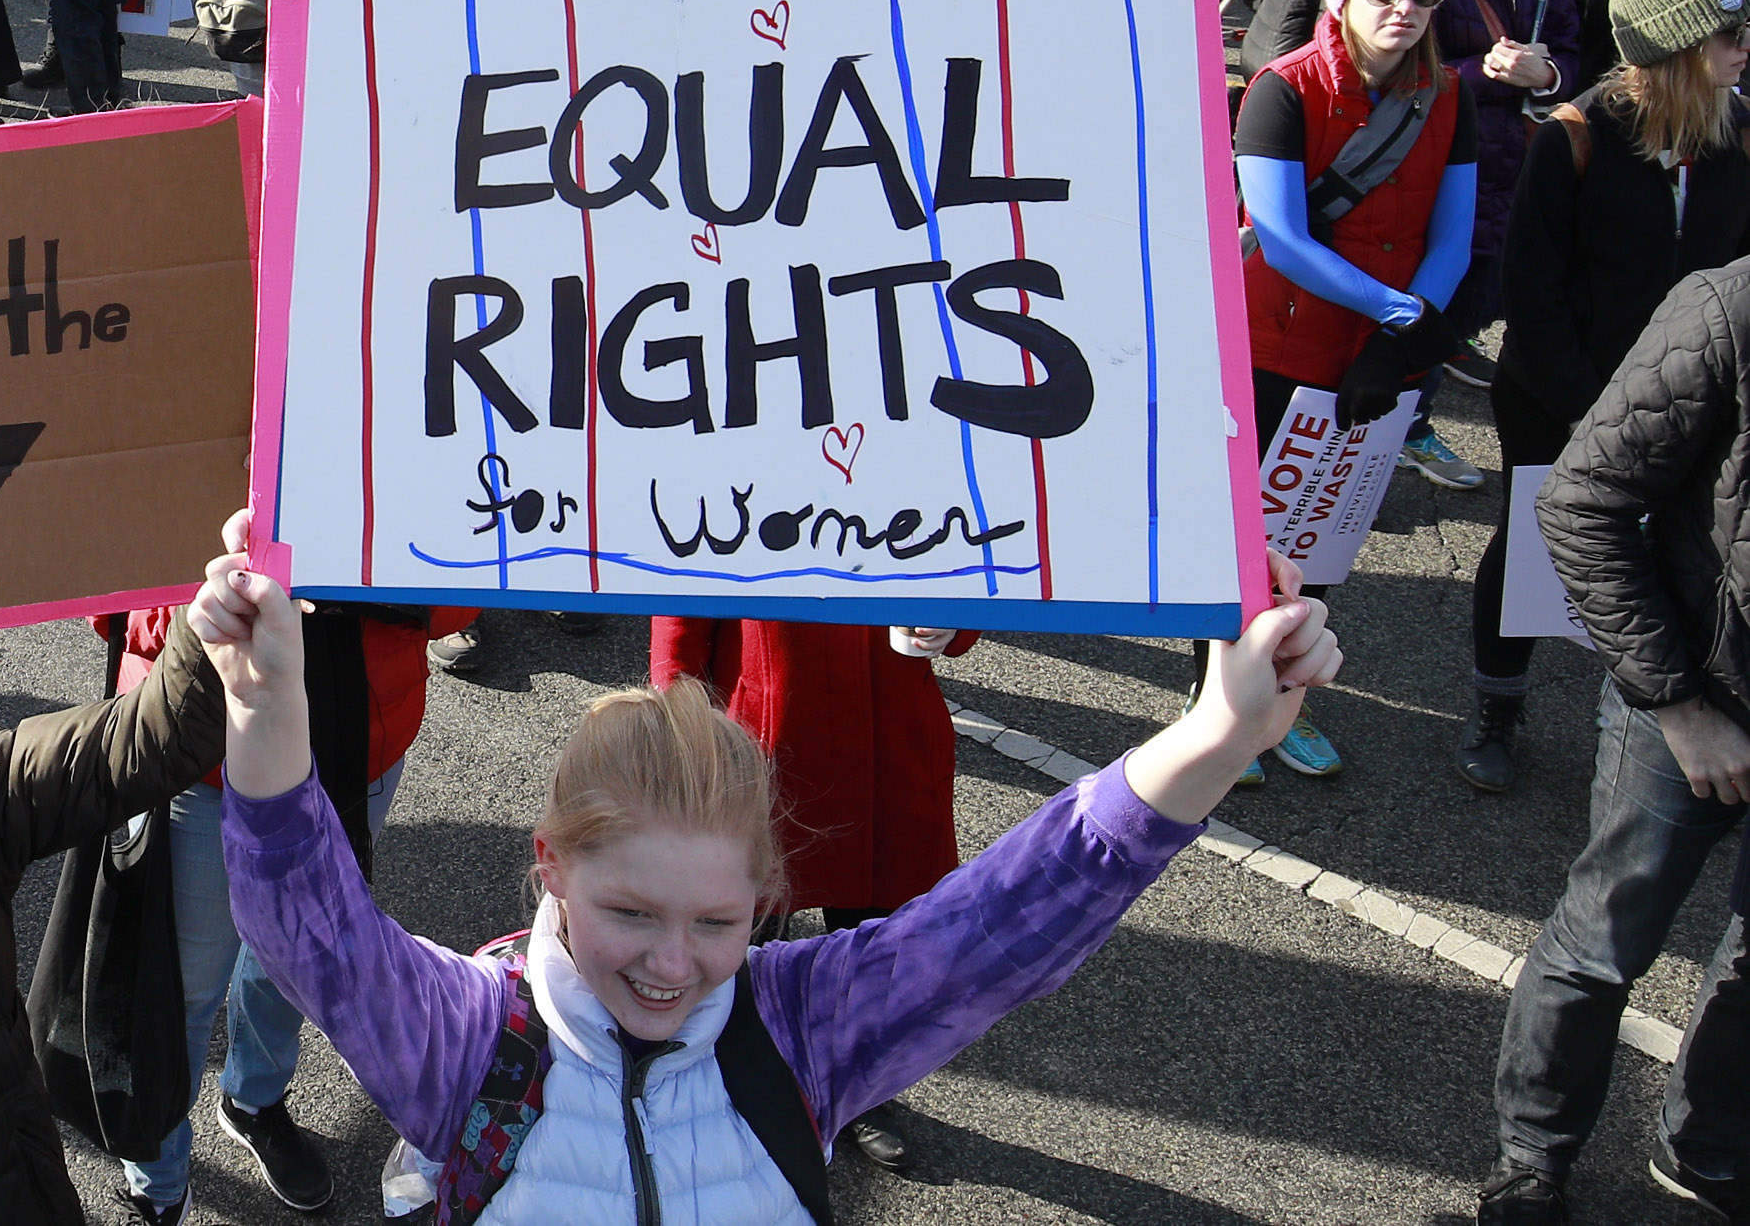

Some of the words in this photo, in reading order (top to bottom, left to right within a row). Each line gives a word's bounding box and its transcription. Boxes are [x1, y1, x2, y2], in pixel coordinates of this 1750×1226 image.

[454, 53, 1072, 230] EQUAL
[424, 258, 1095, 438] RIGHTS
[466, 454, 579, 535] for
[650, 477, 1025, 558] Women
[1261, 412, 1330, 515] VOTE
[1277, 536, 1289, 547] A
[1283, 468, 1326, 534] TERRIBLE
[1318, 429, 1345, 465] THIN
[1287, 531, 1318, 561] TO
[1307, 424, 1369, 523] WASTE
[1338, 453, 1380, 535] INDIVISIBLE
[1359, 467, 1382, 515] CHICAGO
